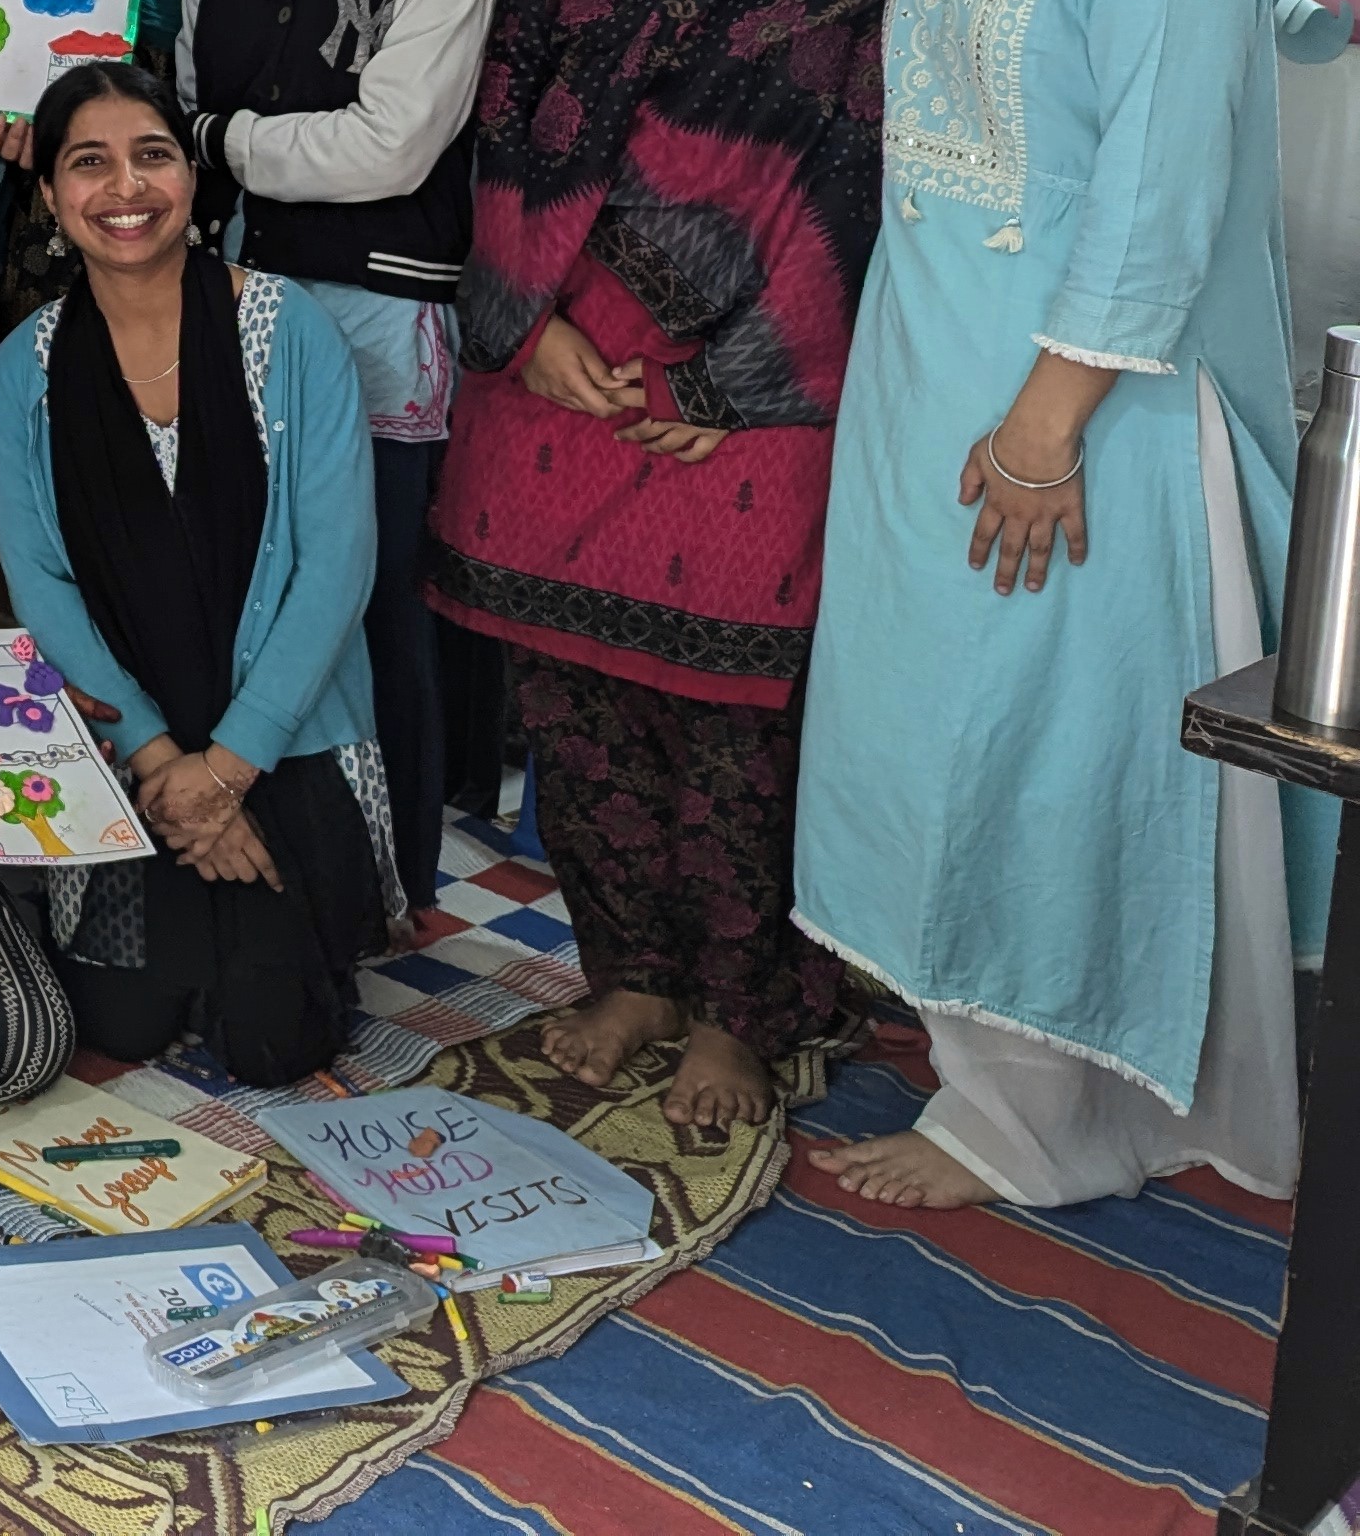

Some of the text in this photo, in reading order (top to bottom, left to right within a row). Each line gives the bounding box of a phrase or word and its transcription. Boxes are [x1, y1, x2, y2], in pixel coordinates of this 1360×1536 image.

[353, 1149, 495, 1205] HOLD
[411, 1175, 589, 1239] VISITS
[166, 1339, 220, 1367] DOMS
